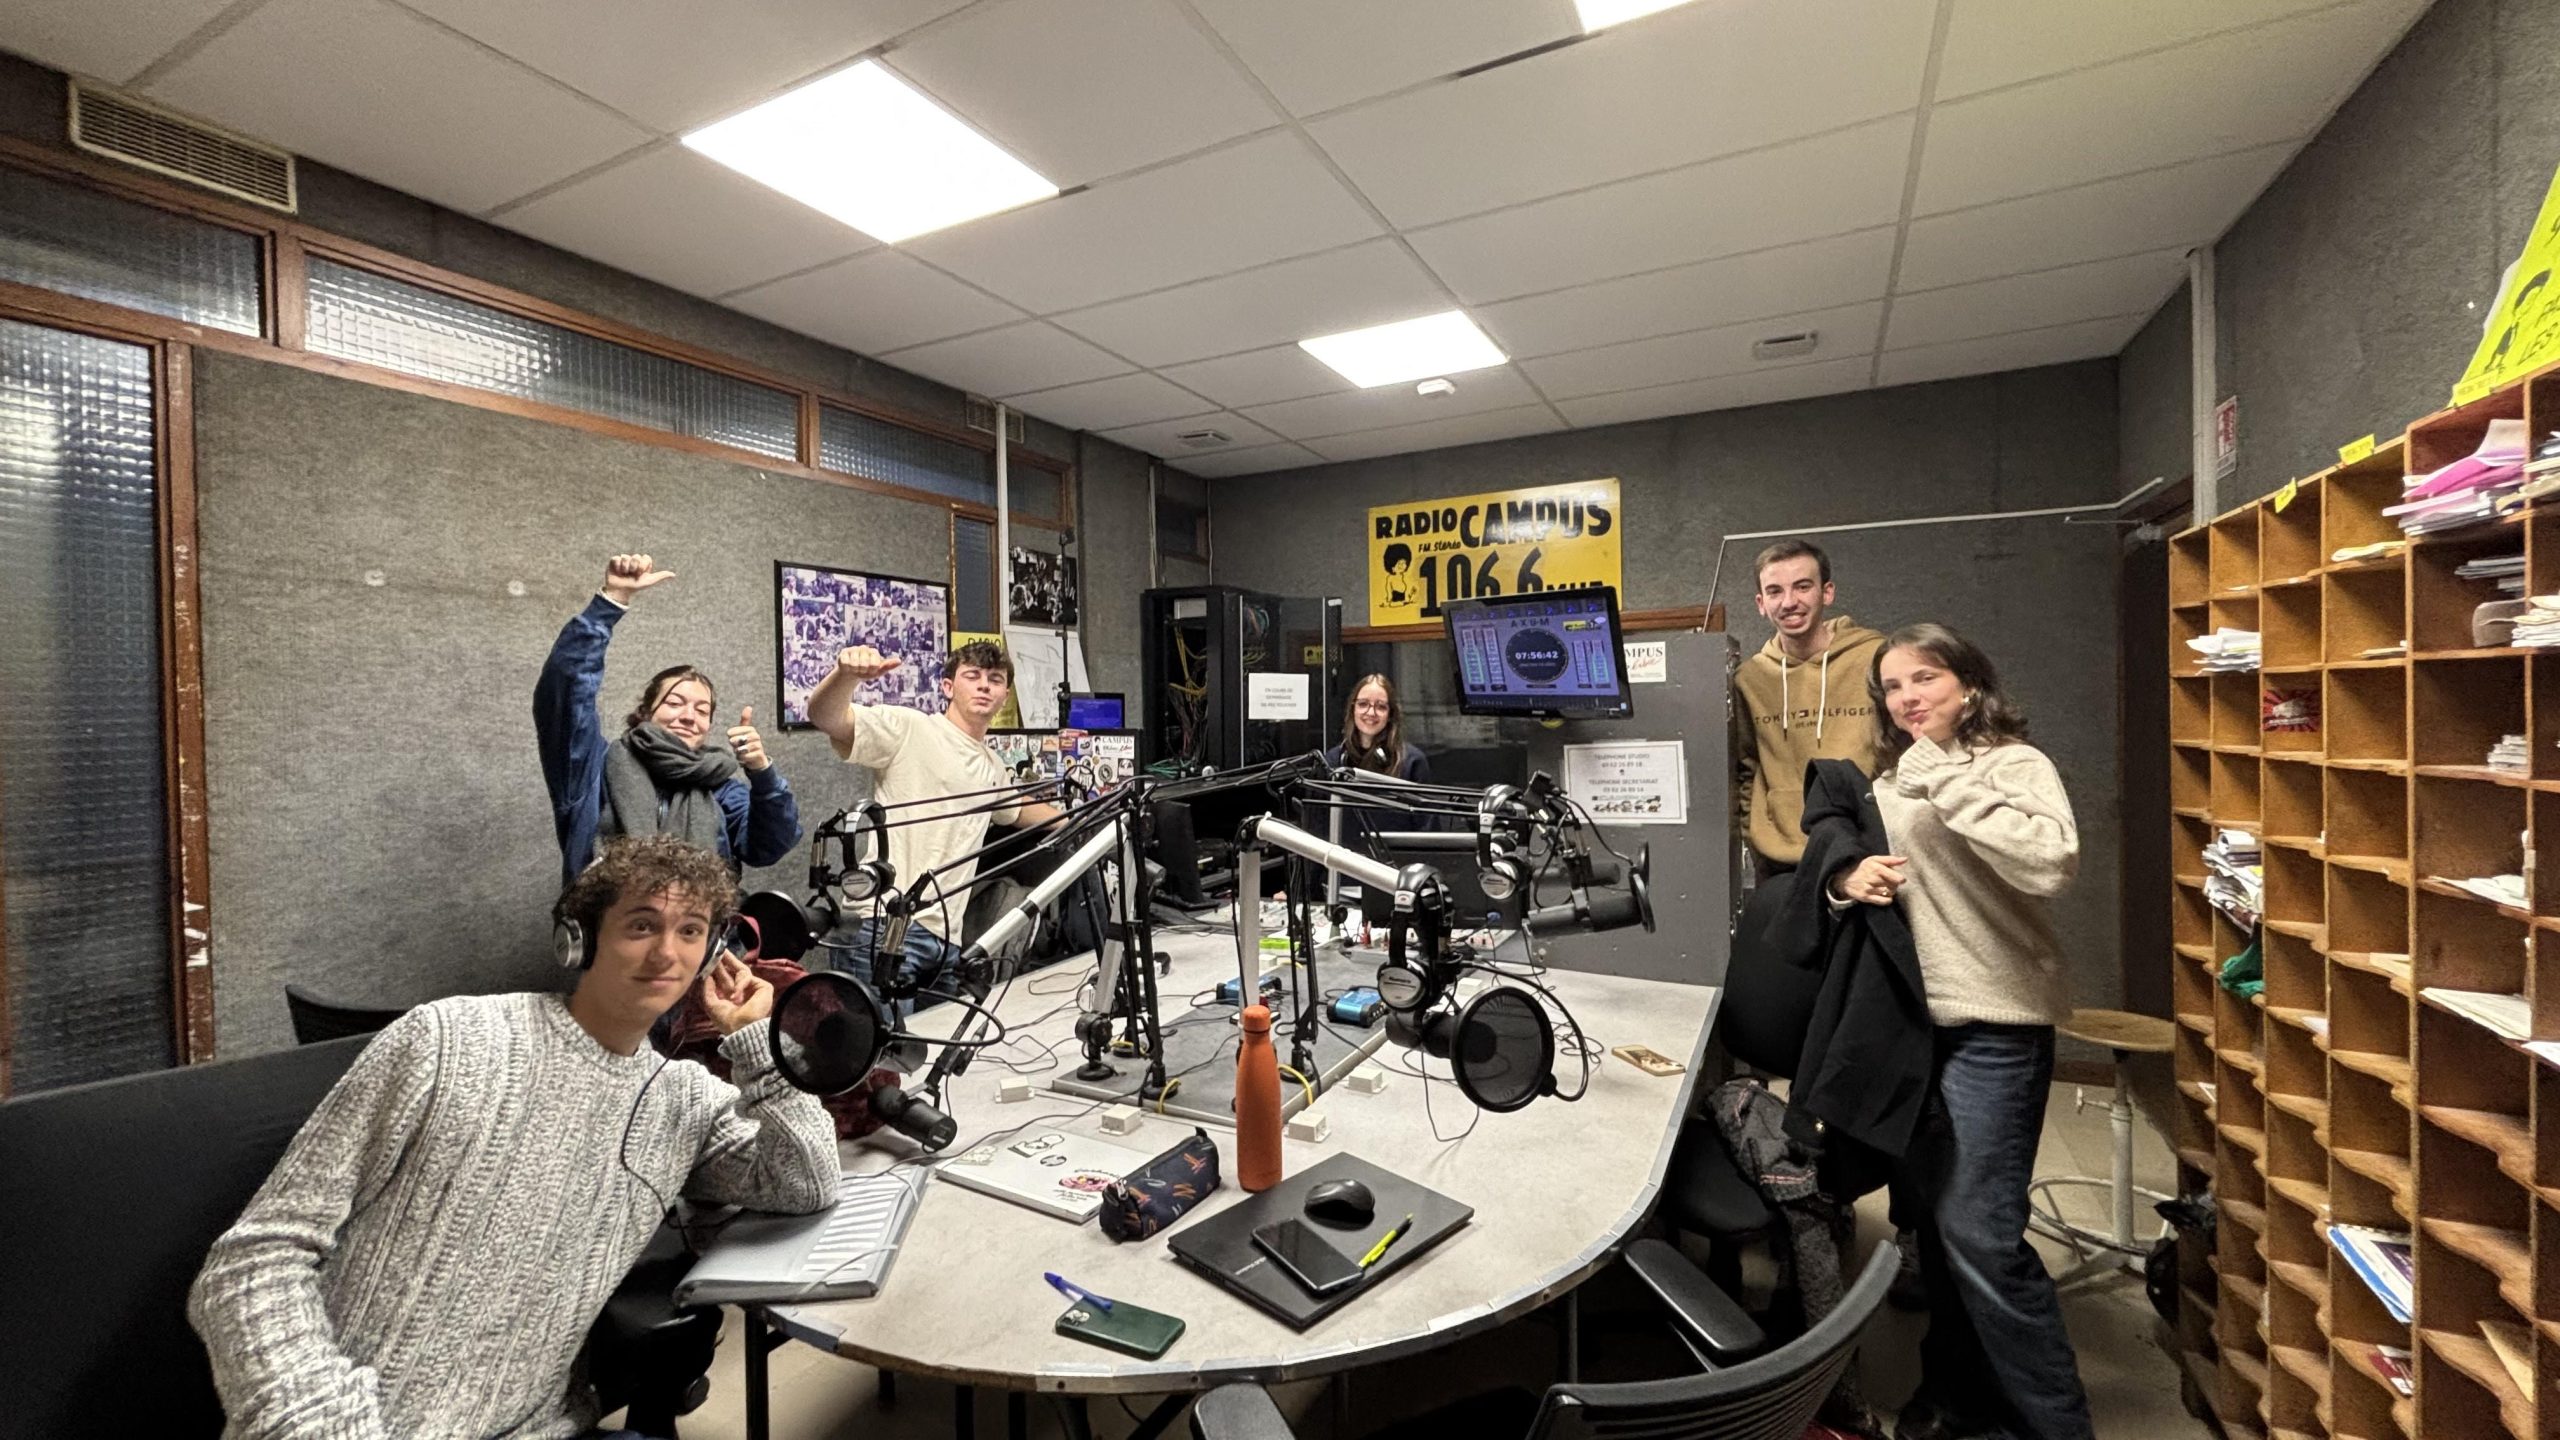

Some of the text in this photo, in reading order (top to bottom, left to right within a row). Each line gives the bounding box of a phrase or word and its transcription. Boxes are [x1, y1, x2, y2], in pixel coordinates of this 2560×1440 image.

[1375, 499, 1612, 548] RADIO CAMPUS
[1418, 543, 1431, 552] FM
[1419, 547, 1543, 618] 1066
[1514, 650, 1559, 660] 07:56:42
[1624, 646, 1664, 658] MPUS
[1755, 711, 1797, 724] TOMY
